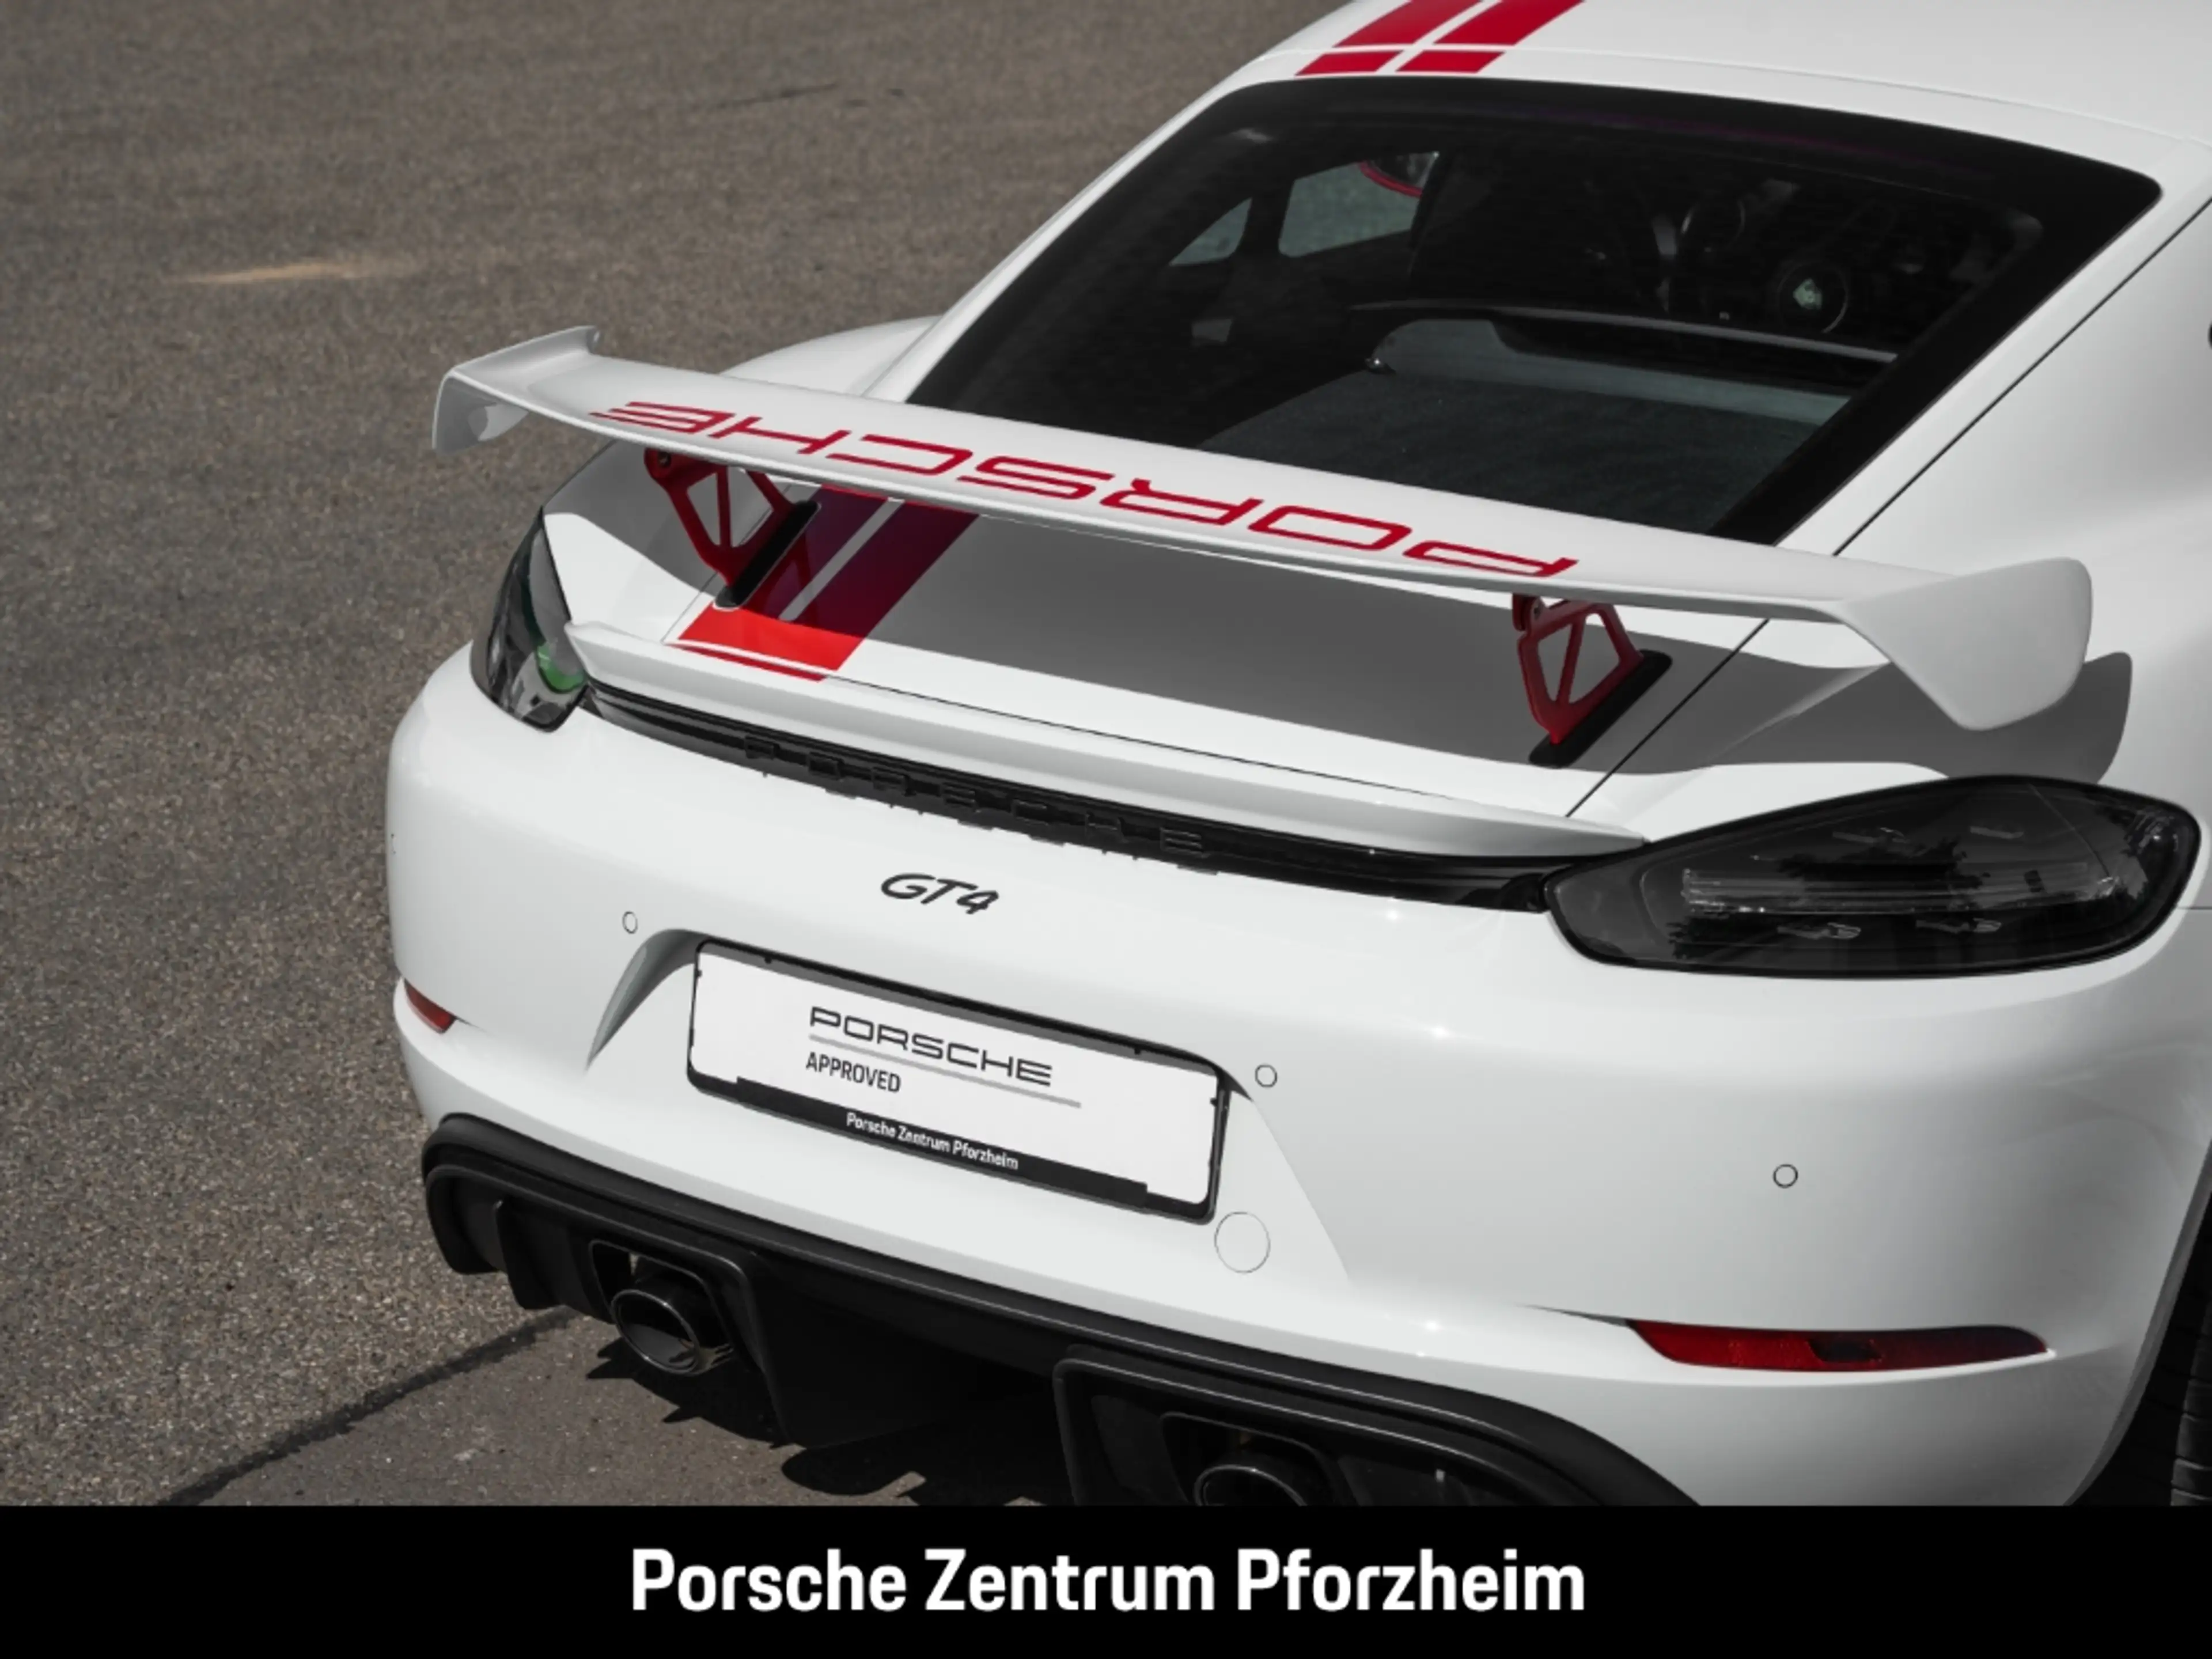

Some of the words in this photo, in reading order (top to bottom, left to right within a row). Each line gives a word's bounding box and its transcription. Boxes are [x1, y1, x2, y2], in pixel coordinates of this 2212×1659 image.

[589, 401, 1577, 578] PORSCHE
[881, 872, 999, 914] GT4
[806, 1051, 901, 1093] APPROVED
[810, 1006, 1052, 1086] PORSCHE
[846, 1112, 896, 1138] Porsche
[897, 1125, 950, 1153] Zentrum
[952, 1140, 1018, 1170] Pforzheim
